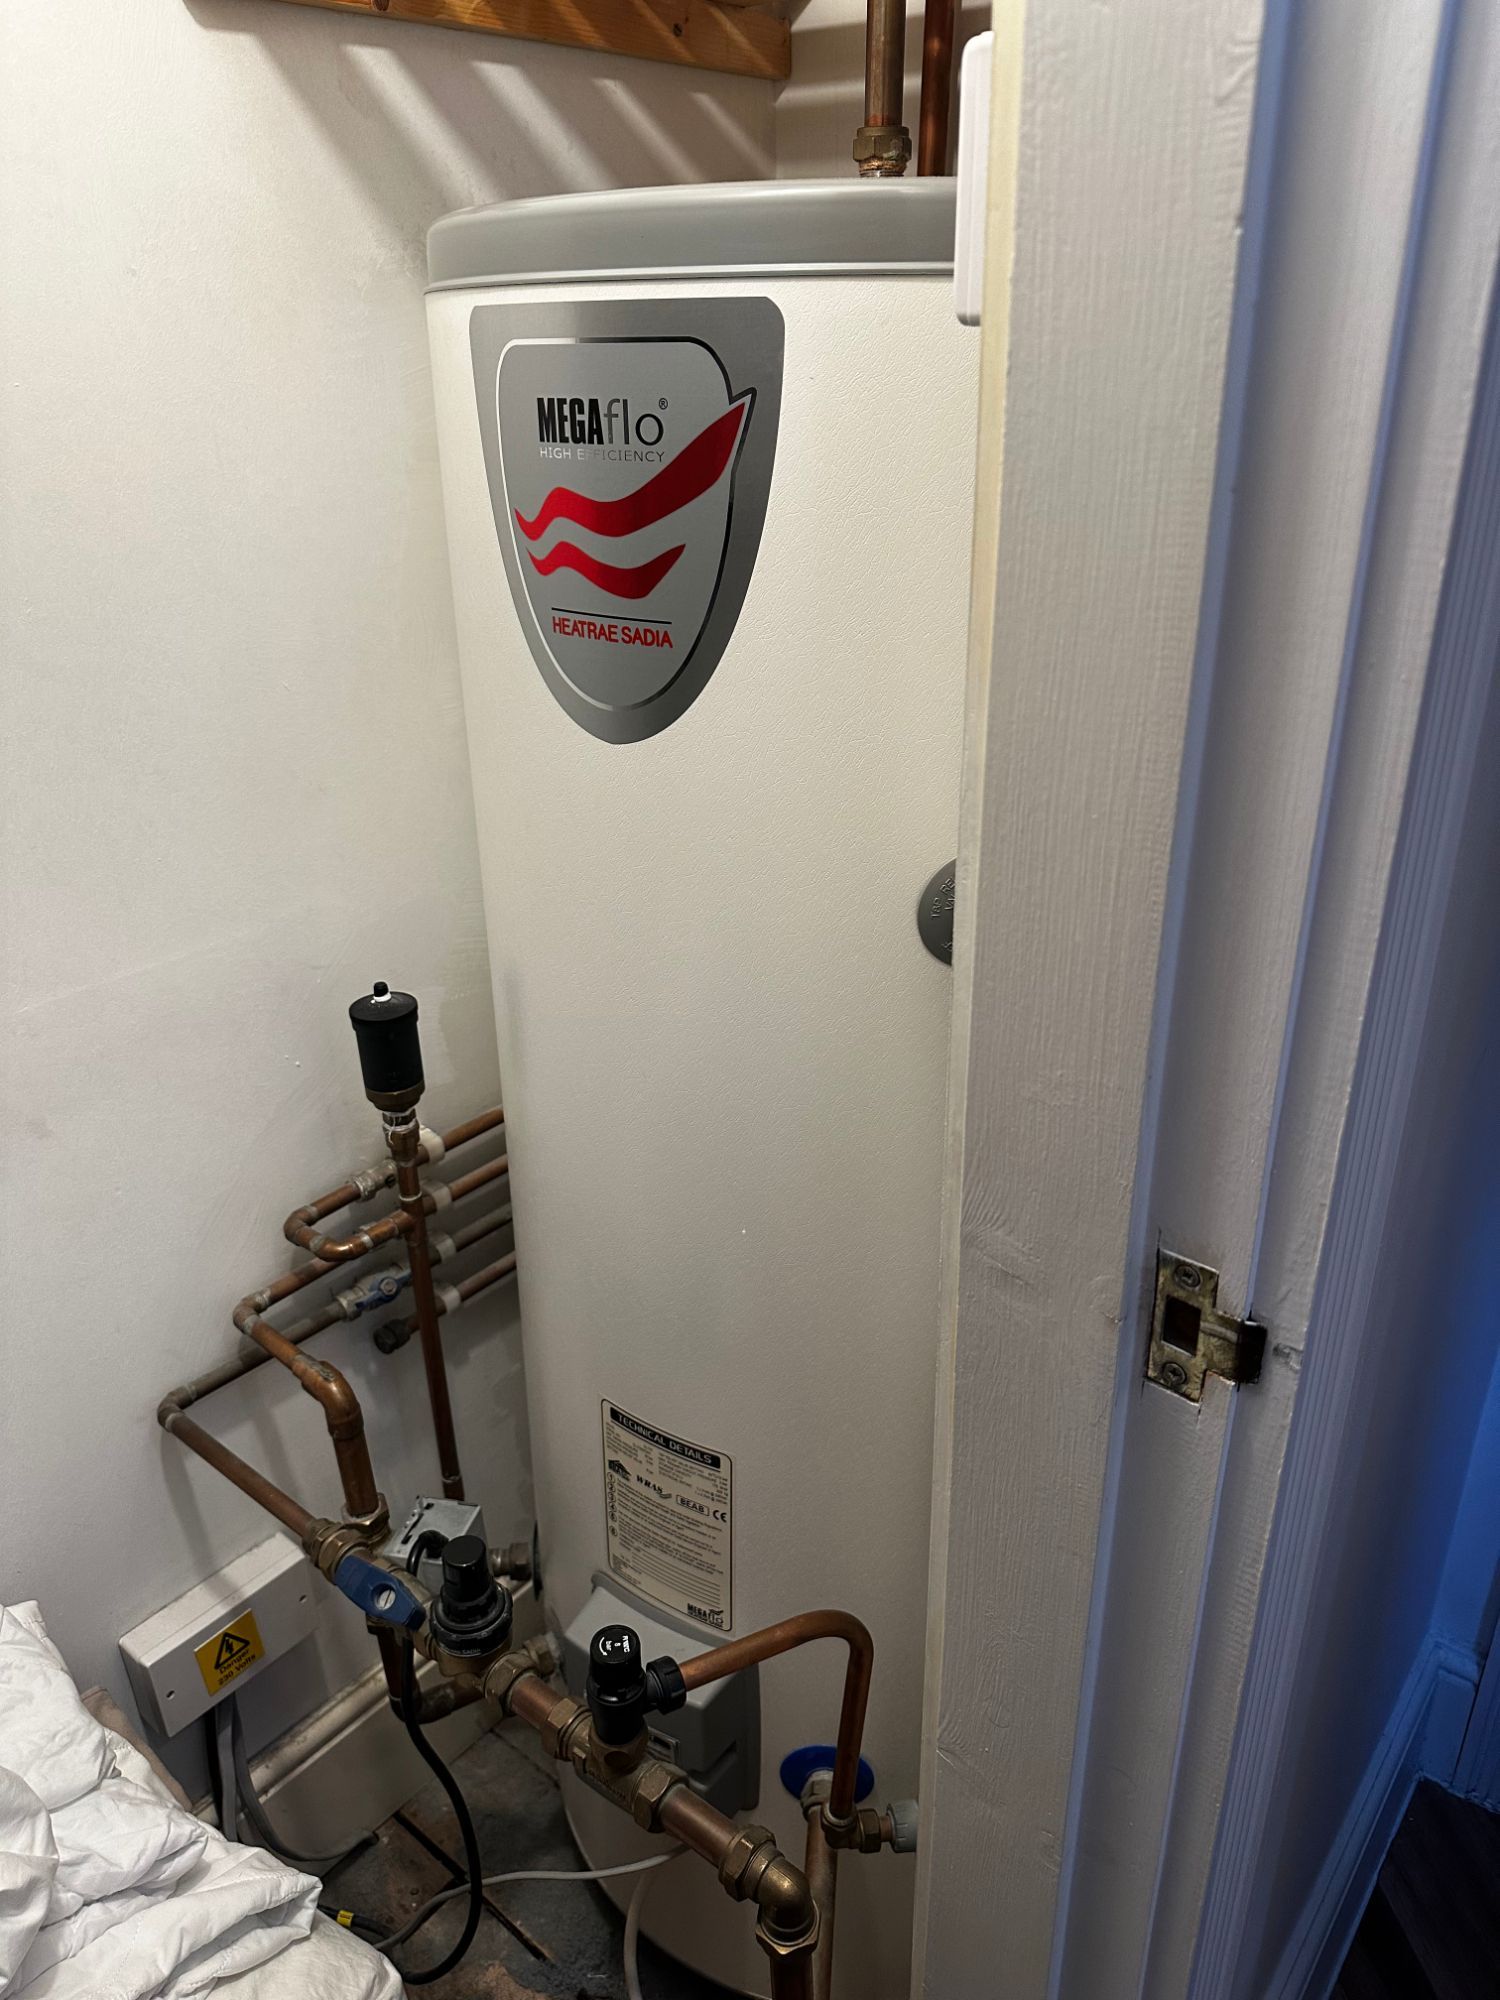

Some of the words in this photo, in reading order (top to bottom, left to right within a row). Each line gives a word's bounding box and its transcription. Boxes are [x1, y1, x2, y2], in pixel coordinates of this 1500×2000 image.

[540, 447, 571, 460] HIGH
[577, 448, 665, 463] EFFICIENCY
[552, 616, 619, 643] HEATRAE
[621, 625, 673, 648] SADIA
[617, 1412, 667, 1447] TECHNICAL
[668, 1439, 713, 1464] DETAILS
[636, 1474, 663, 1494] WRAS
